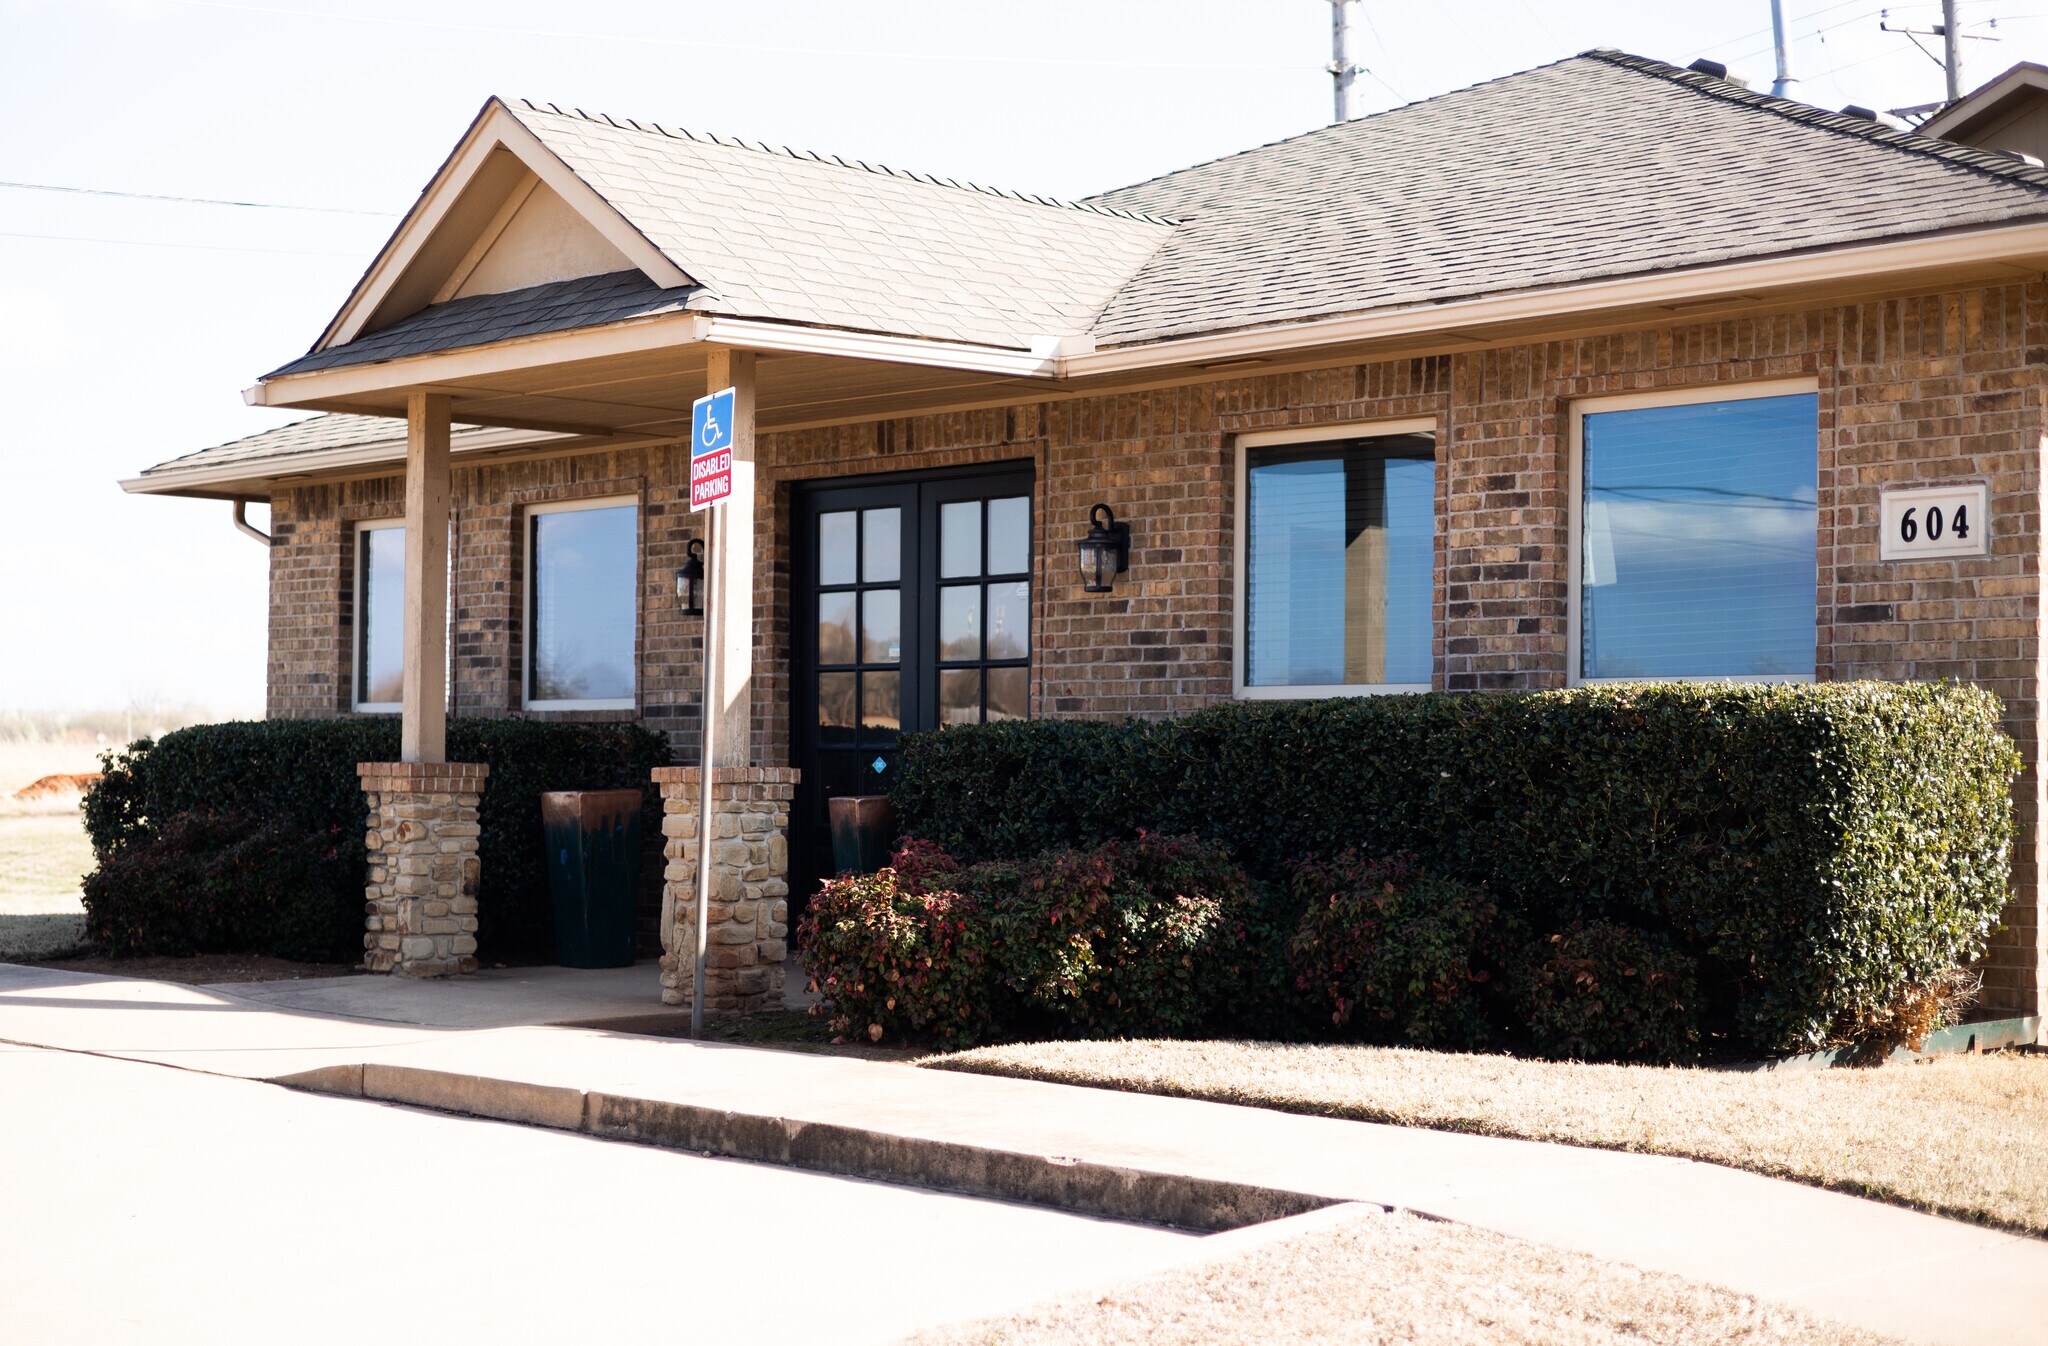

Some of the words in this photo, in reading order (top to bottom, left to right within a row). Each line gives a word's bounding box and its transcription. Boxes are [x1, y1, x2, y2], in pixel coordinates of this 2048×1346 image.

[693, 452, 730, 481] DISABLED
[694, 475, 729, 502] PARKING
[1901, 504, 1969, 543] 604
